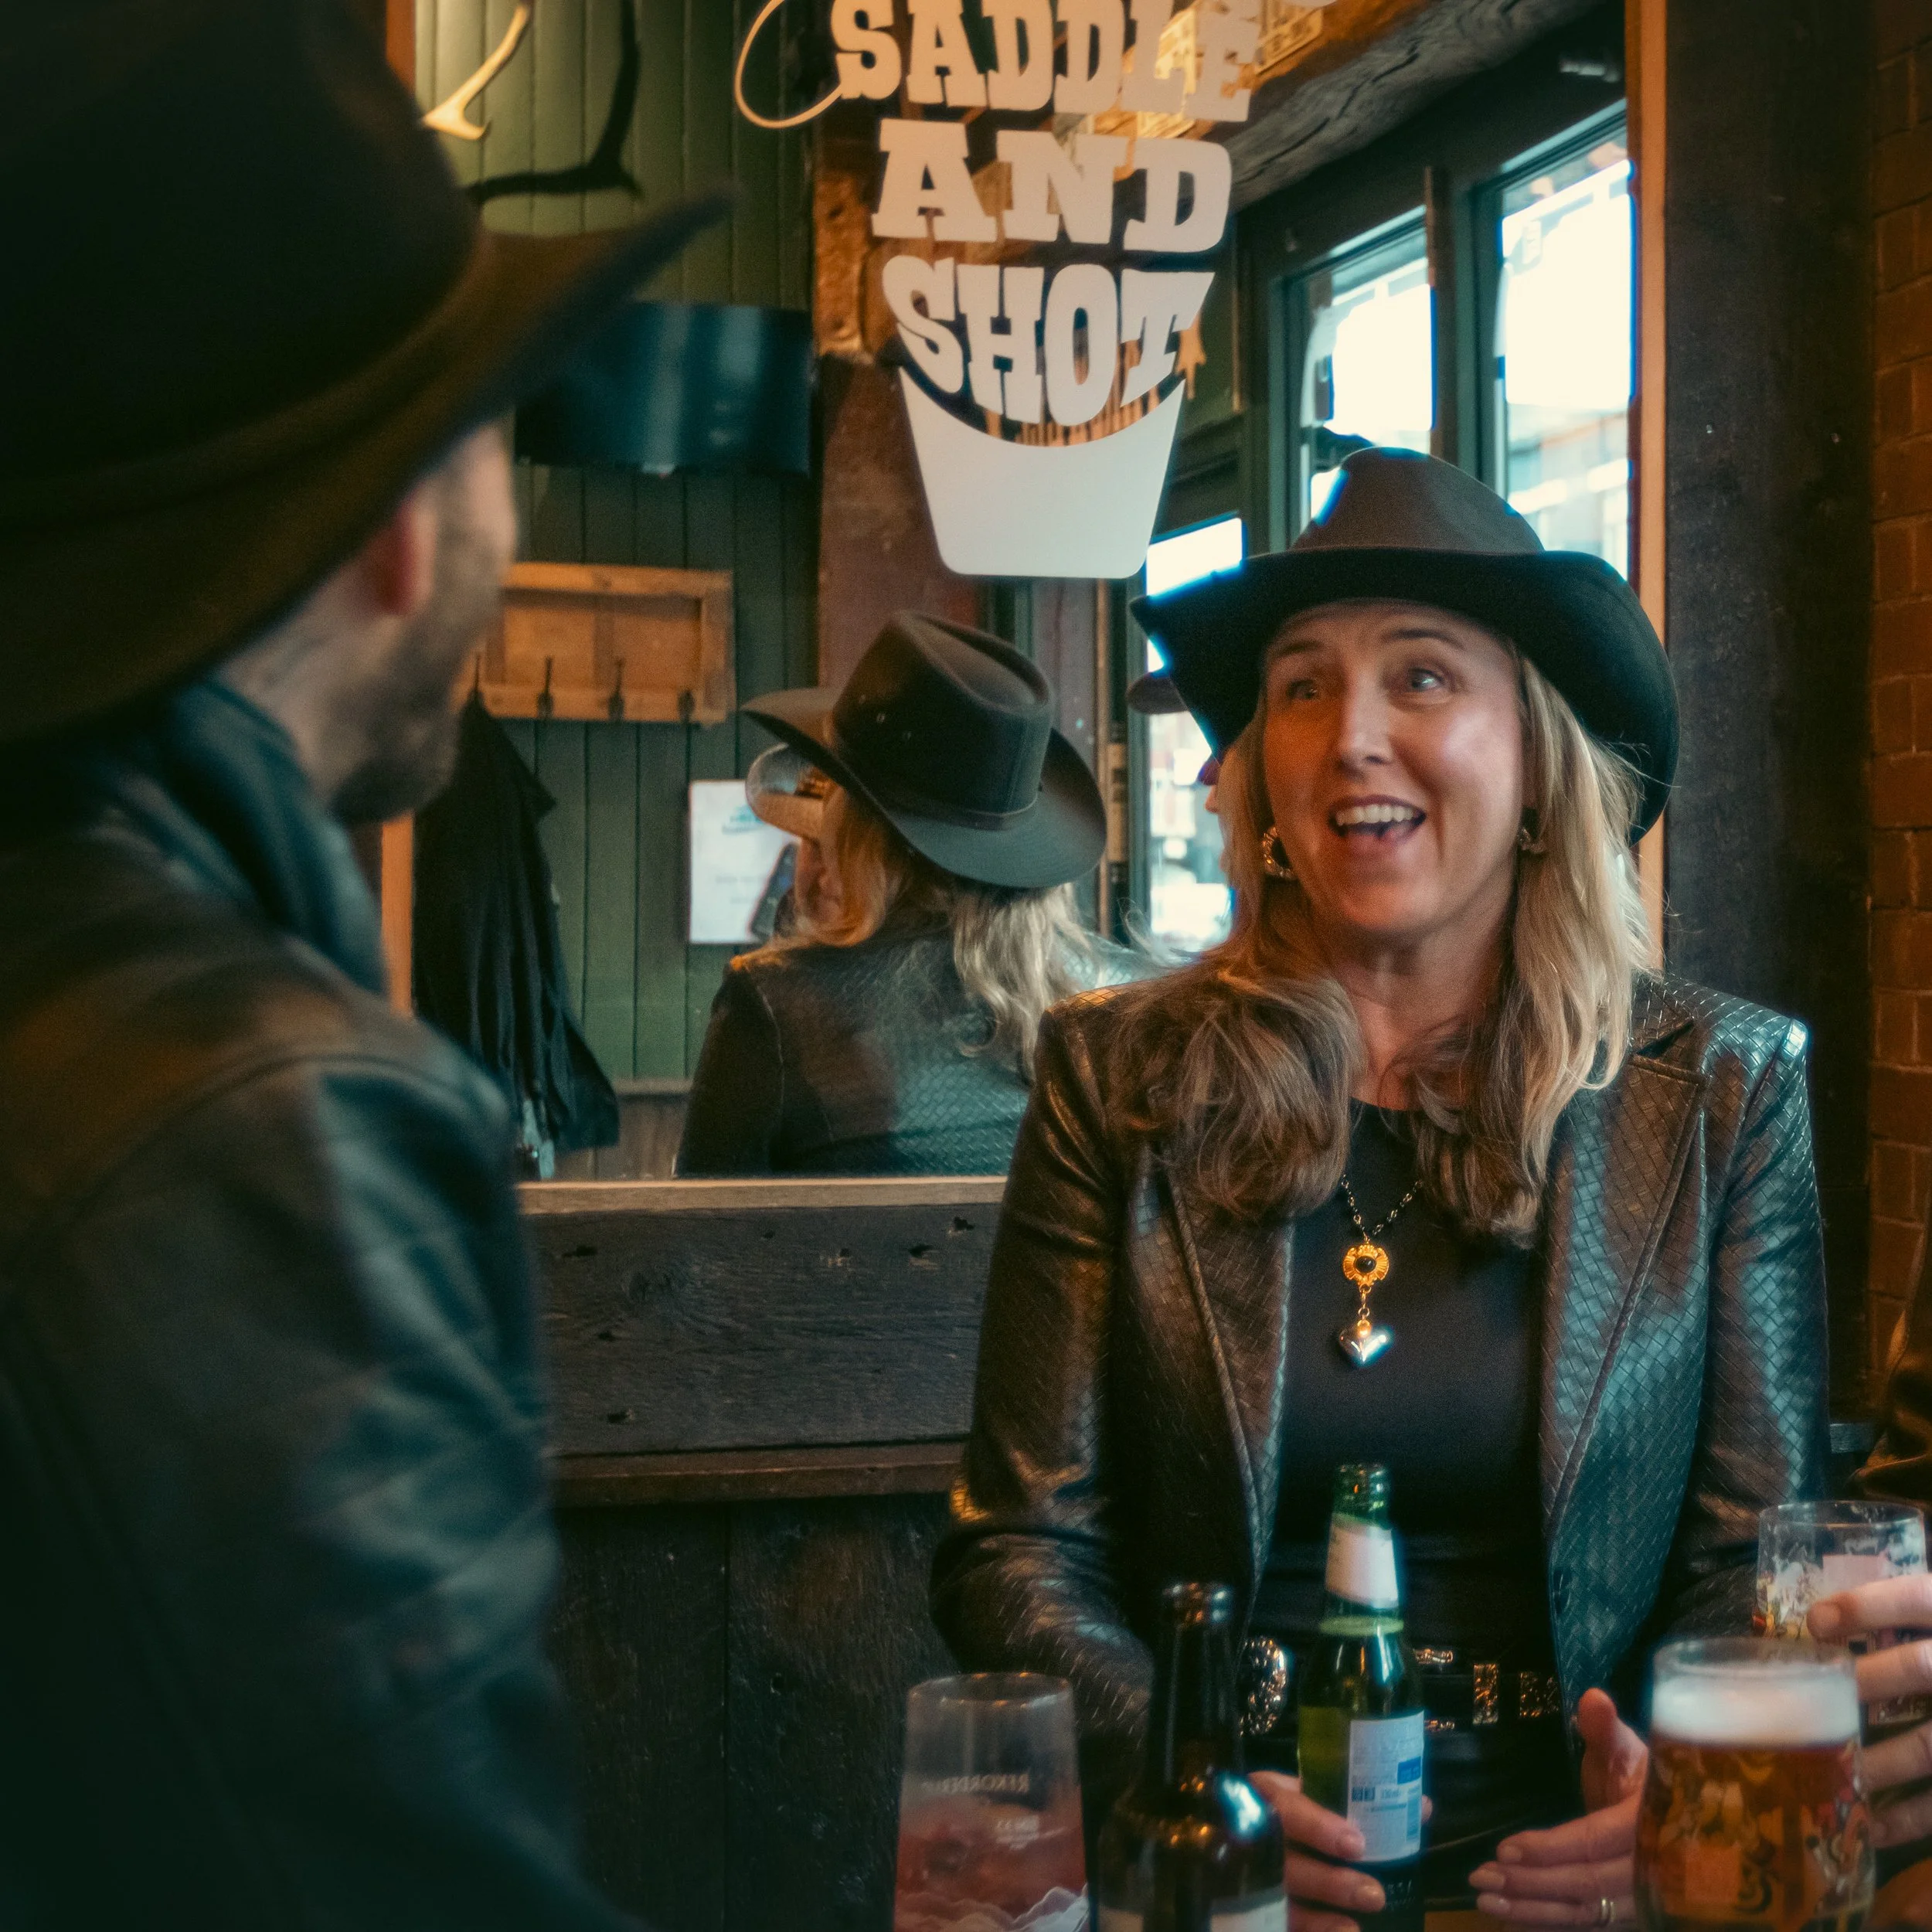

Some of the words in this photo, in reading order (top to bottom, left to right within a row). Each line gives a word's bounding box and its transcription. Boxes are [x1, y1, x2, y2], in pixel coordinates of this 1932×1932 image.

[831, 0, 1260, 121] SADDLE
[872, 120, 1232, 252] AND
[882, 256, 1215, 426] SHOT
